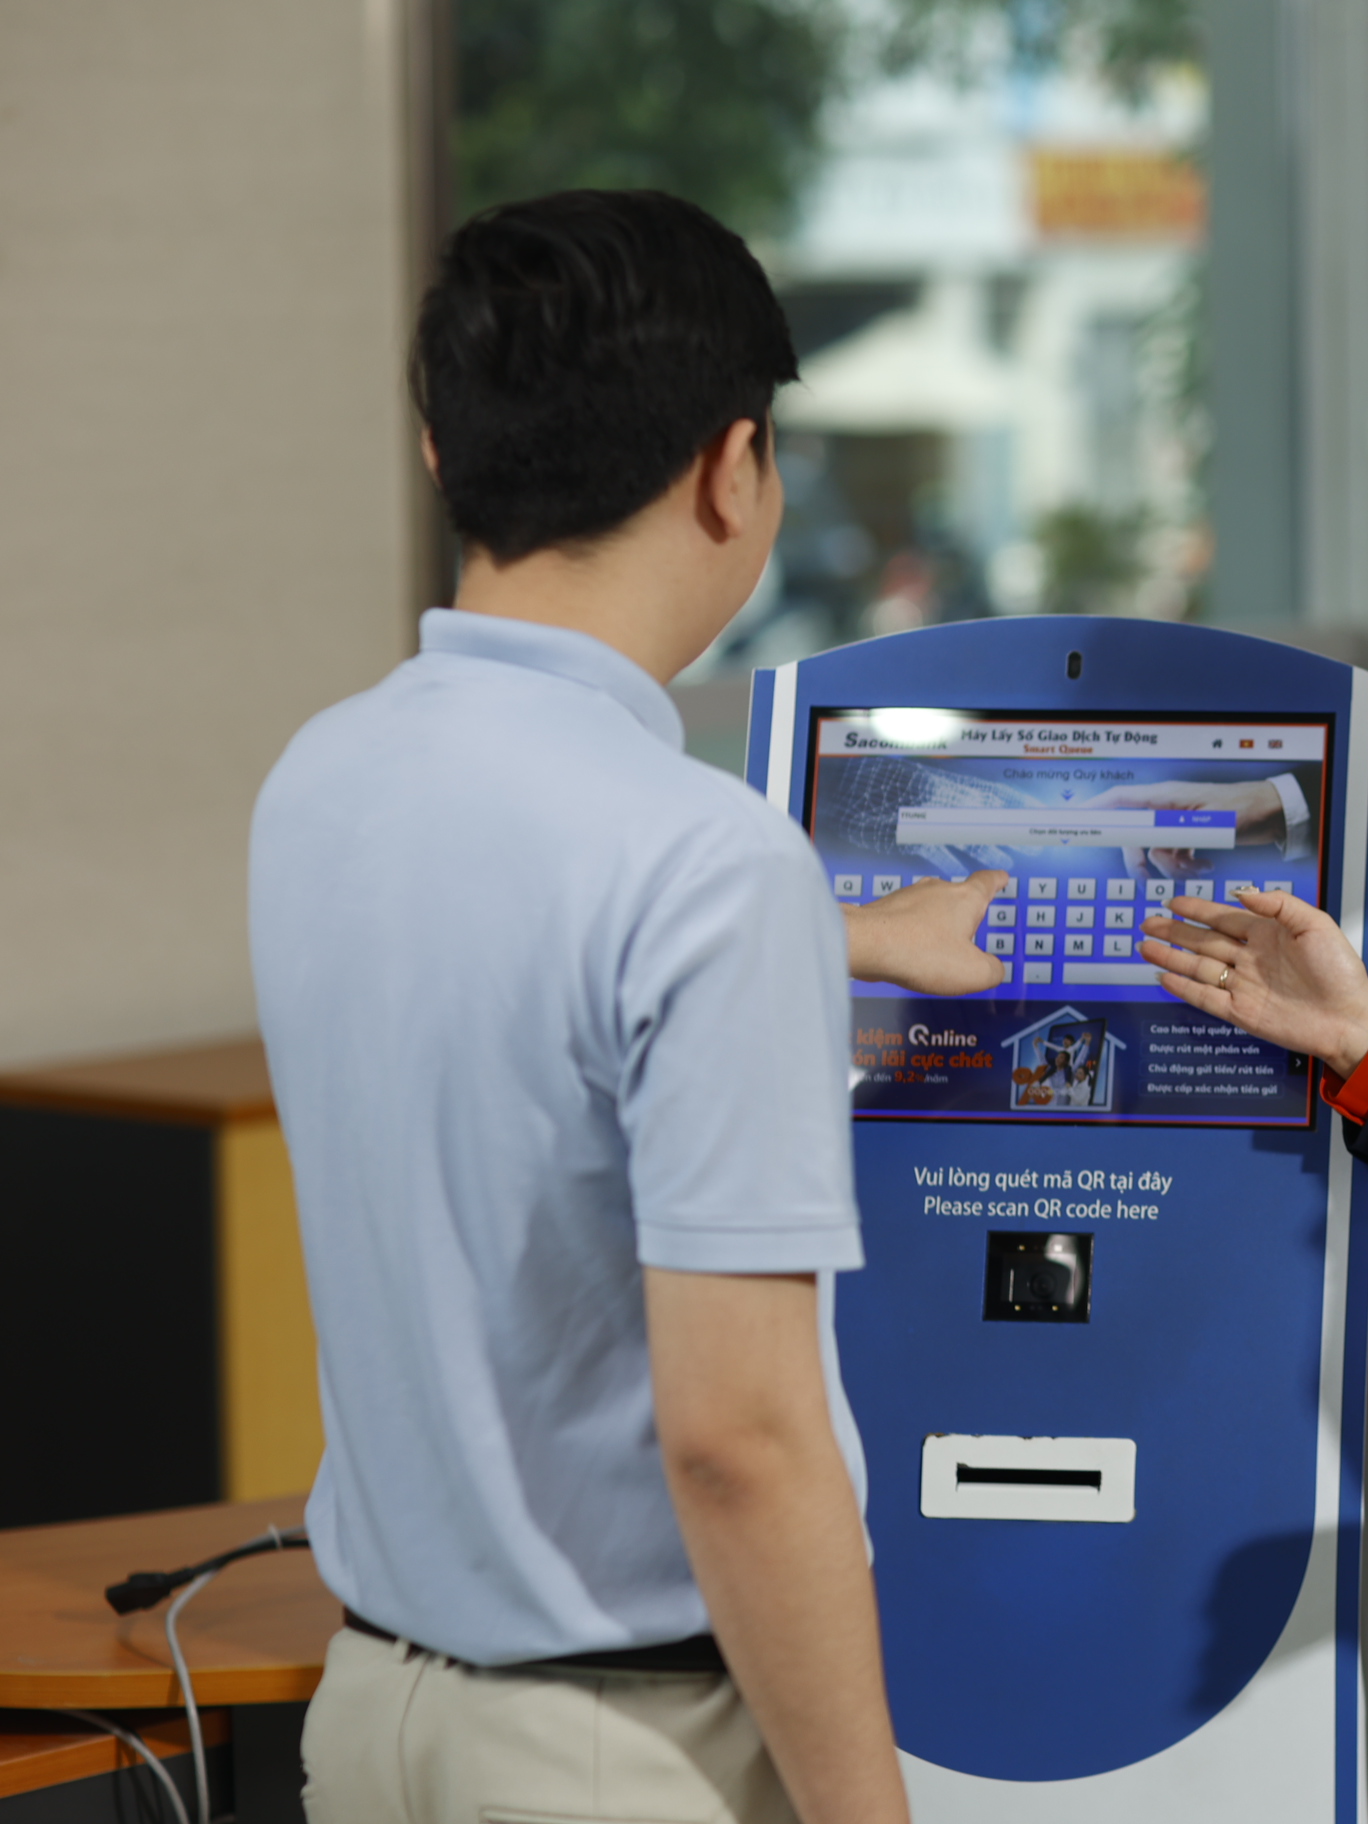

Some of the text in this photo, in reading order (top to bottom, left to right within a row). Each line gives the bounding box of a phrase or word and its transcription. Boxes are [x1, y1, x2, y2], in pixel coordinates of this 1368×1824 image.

[961, 728, 1159, 745] Máy Lấy Số Giao Dịch Tự Động
[1023, 743, 1094, 756] Smart Queue
[1003, 767, 1034, 780] Chào
[1100, 769, 1135, 781] khách
[843, 880, 894, 892] Q W
[1038, 882, 1048, 894] Y
[1077, 883, 1087, 895] U
[1195, 885, 1204, 896] 7
[996, 911, 1124, 924] G H J K
[996, 938, 1122, 951] B N M L
[1150, 1024, 1170, 1035] Cao
[856, 1028, 904, 1048] kiệm
[881, 1049, 907, 1067] lãi
[911, 1051, 945, 1071] cực
[949, 1050, 995, 1068] chất
[873, 1071, 892, 1083] đến
[914, 1166, 1173, 1196] Vui lòng quét mã QR tại đây
[923, 1195, 1160, 1221] Please scan QR code here
